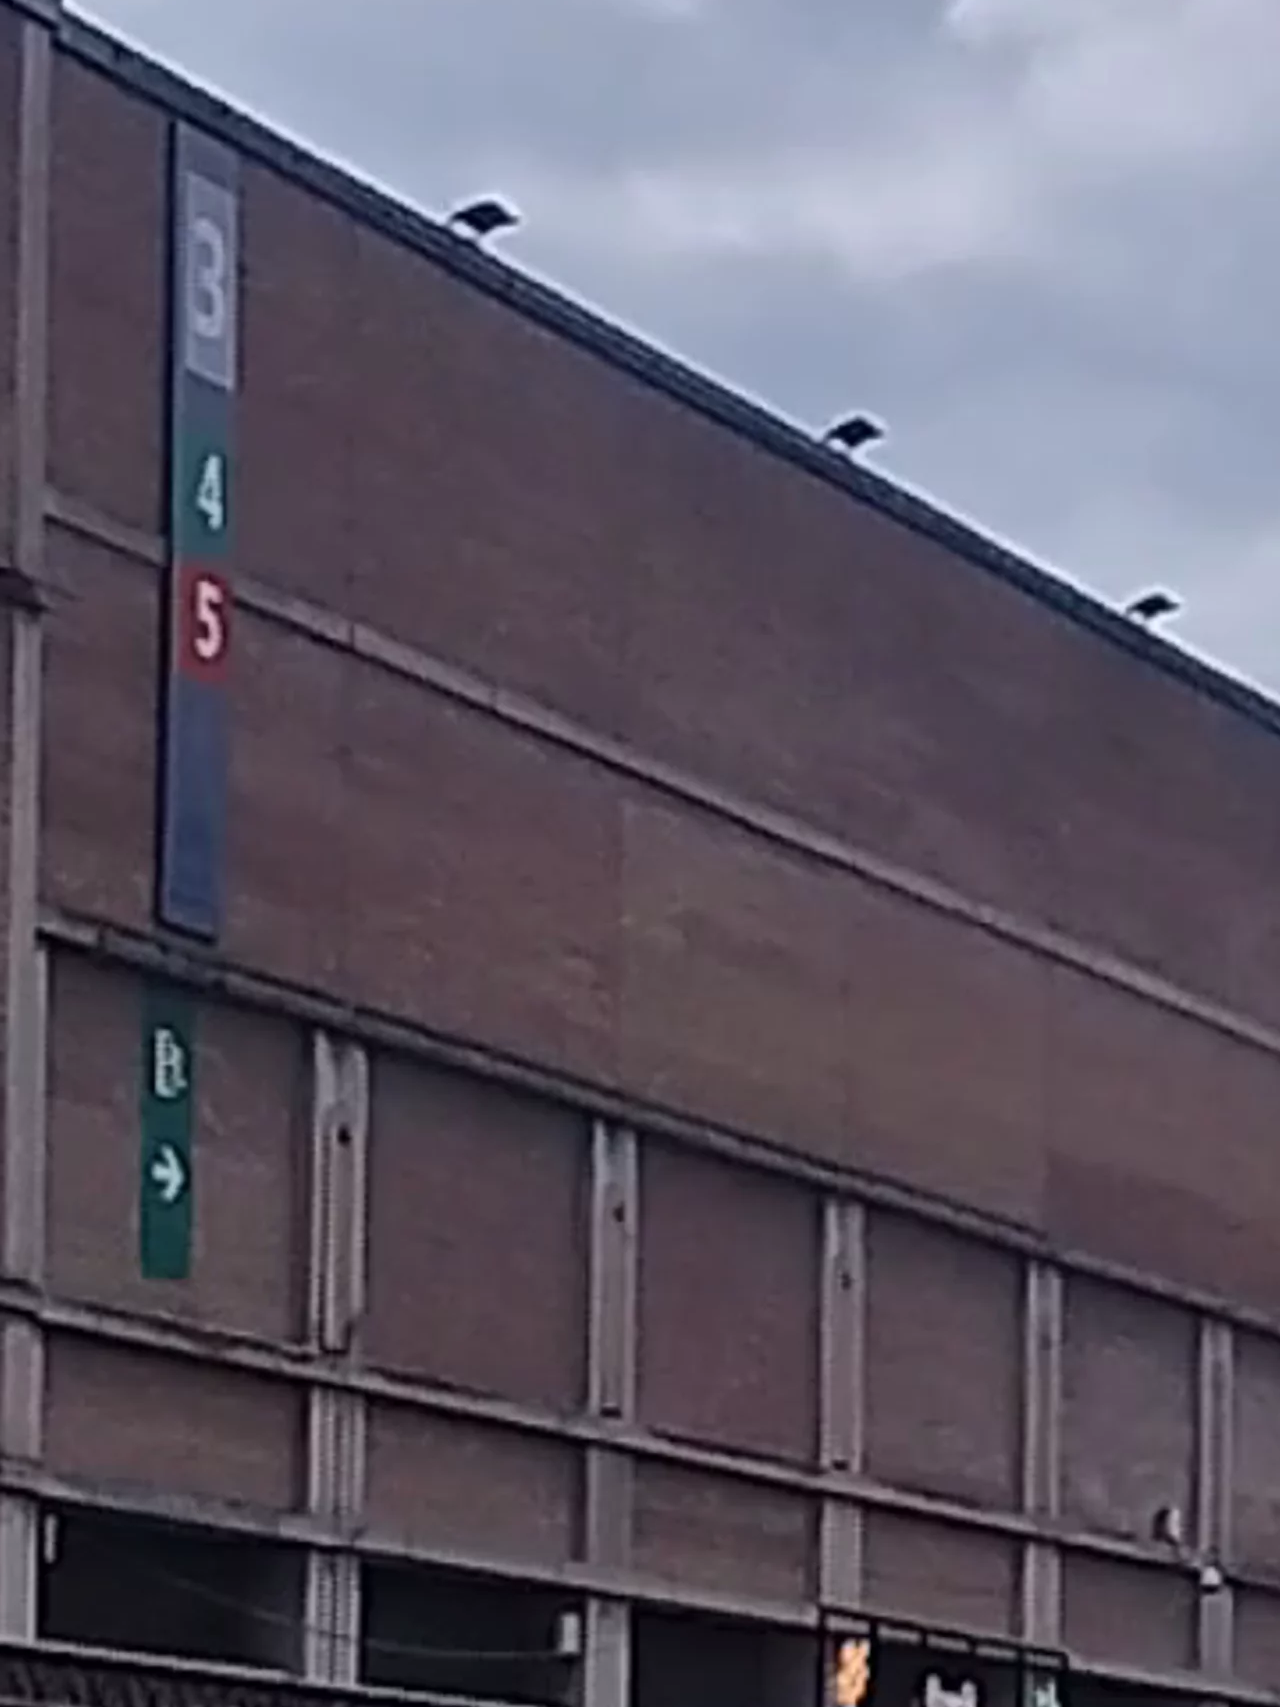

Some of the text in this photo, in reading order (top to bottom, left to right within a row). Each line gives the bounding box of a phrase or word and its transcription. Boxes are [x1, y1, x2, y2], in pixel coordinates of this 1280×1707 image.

[191, 216, 225, 339] 3
[196, 453, 224, 530] 4
[193, 579, 224, 660] 5
